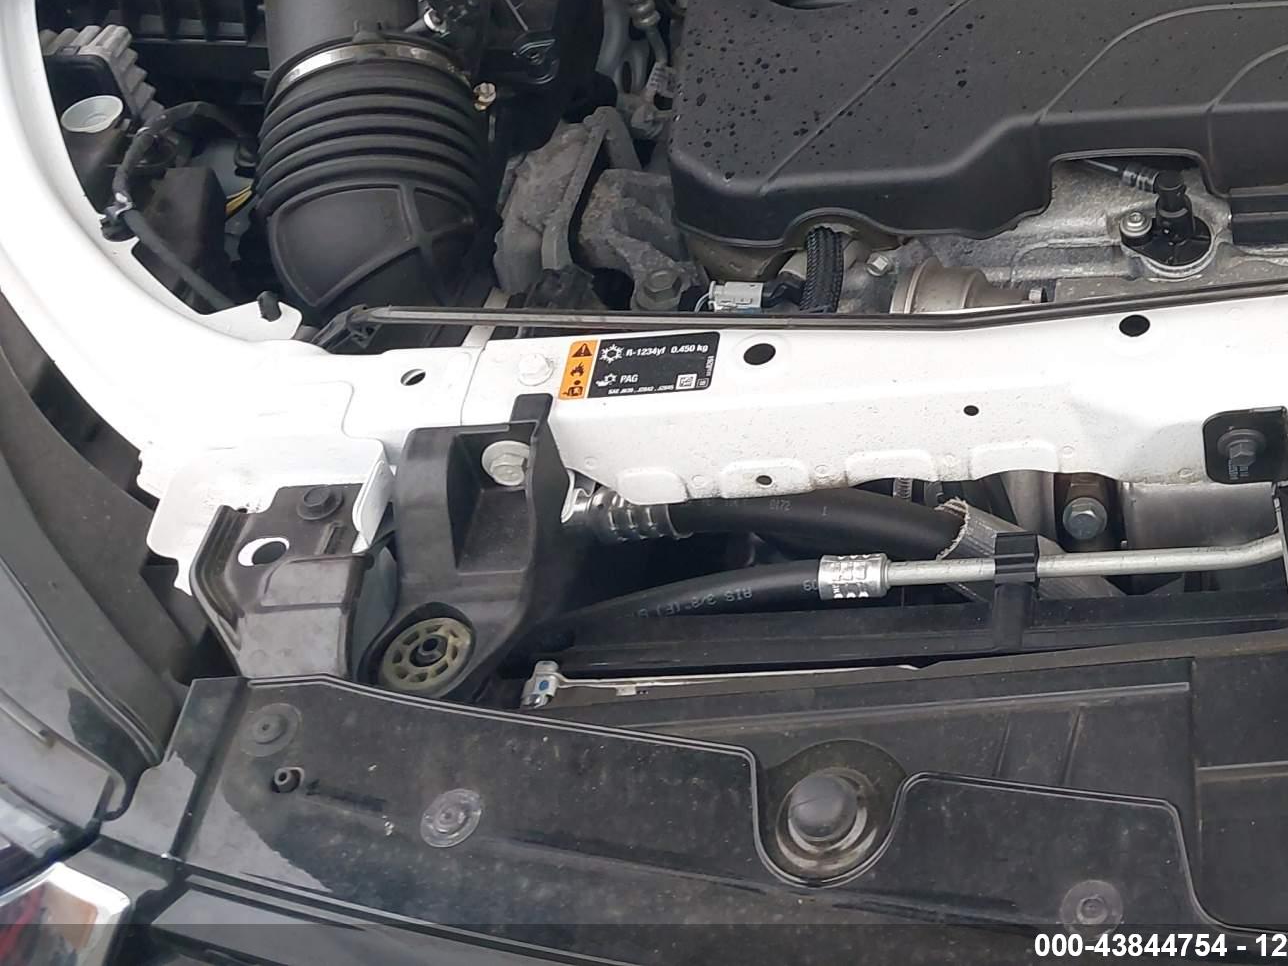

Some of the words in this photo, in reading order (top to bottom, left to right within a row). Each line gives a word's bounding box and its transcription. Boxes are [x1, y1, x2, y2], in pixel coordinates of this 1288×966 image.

[670, 344, 695, 354] 0.450
[696, 344, 709, 353] kg
[619, 374, 639, 383] PAG
